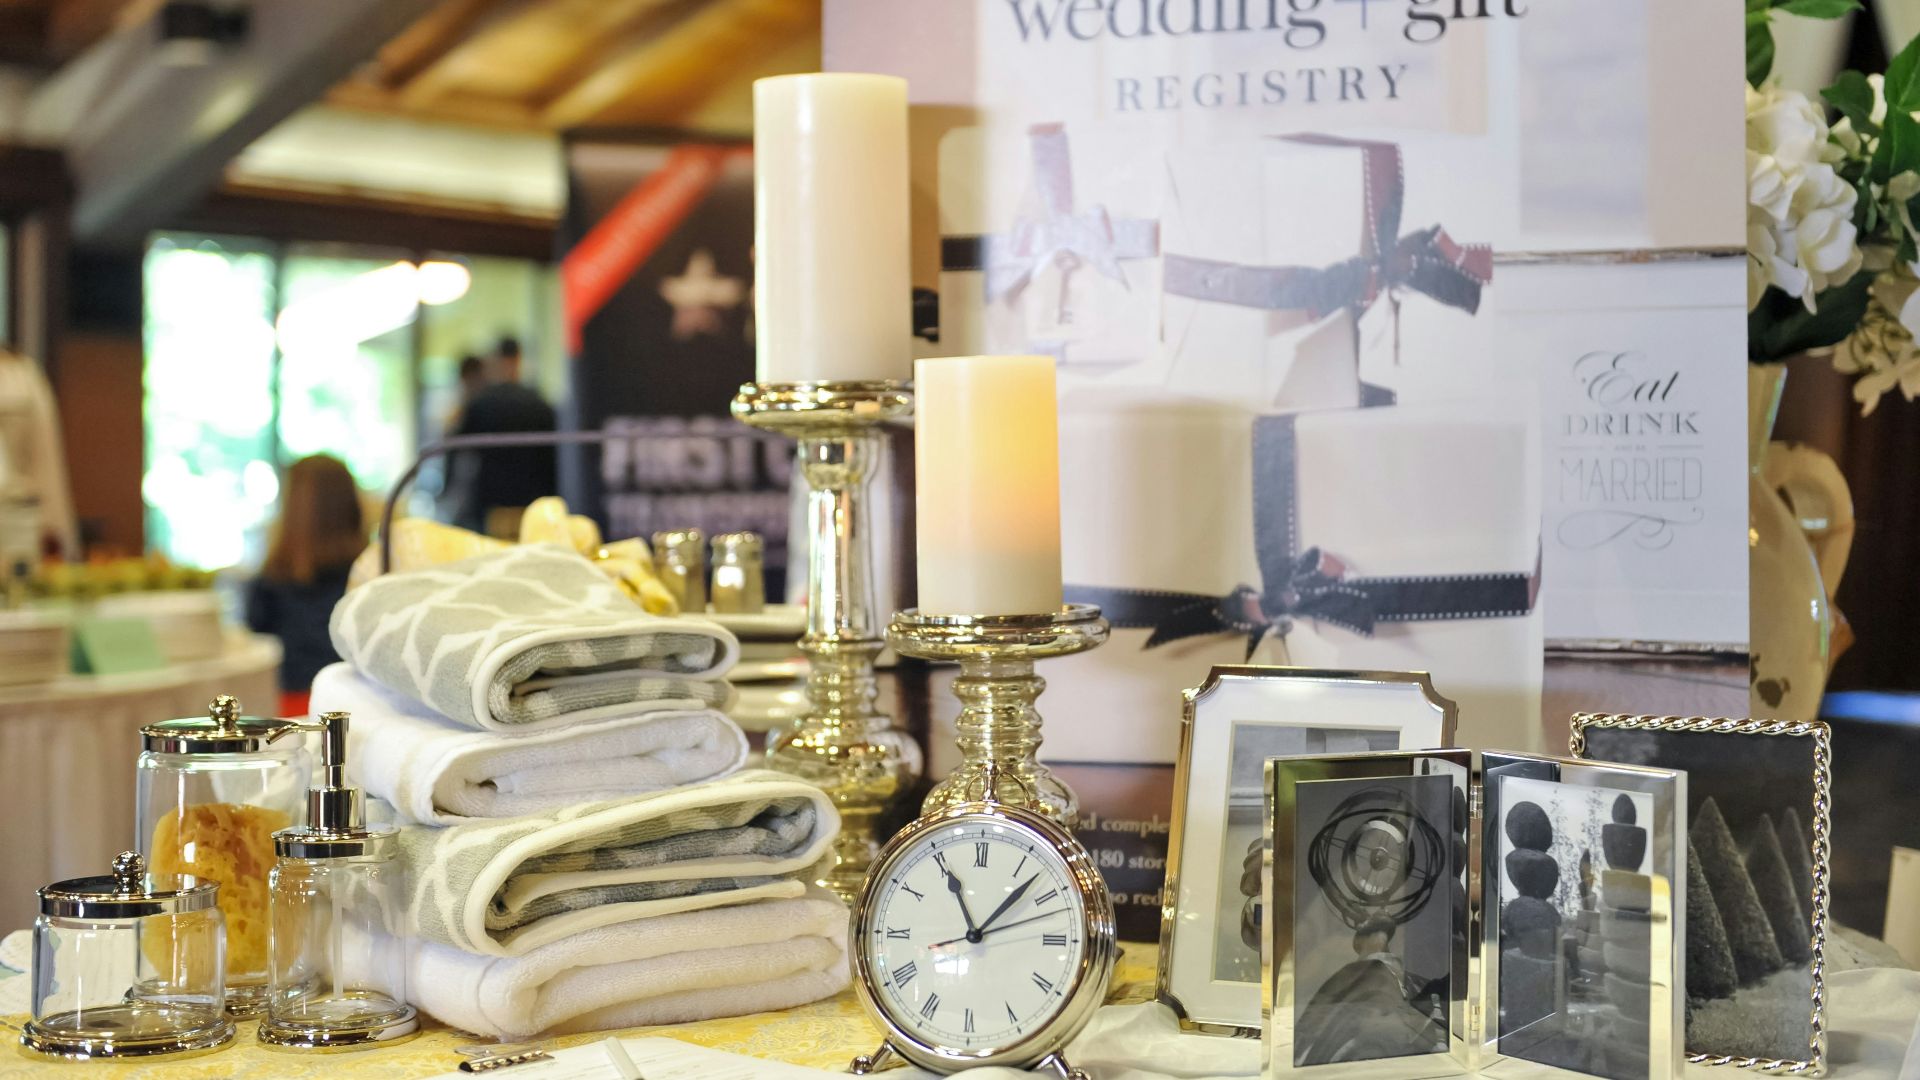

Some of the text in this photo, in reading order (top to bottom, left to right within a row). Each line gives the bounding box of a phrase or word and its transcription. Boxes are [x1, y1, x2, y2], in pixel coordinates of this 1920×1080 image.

[1115, 64, 1409, 113] REGISTRY
[1573, 350, 1680, 406] Eat
[1562, 411, 1700, 436] DRINK
[1560, 456, 1703, 502] MARRIED
[1101, 814, 1170, 838] comple
[974, 842, 989, 868] XII
[1128, 856, 1167, 869] stor
[901, 882, 924, 901] X
[1034, 889, 1058, 906] II
[1132, 887, 1163, 906] red
[887, 926, 911, 940] IX
[1043, 934, 1067, 947] III
[920, 992, 941, 1021] VII
[1005, 1000, 1019, 1024] V
[964, 1008, 975, 1033] VI
